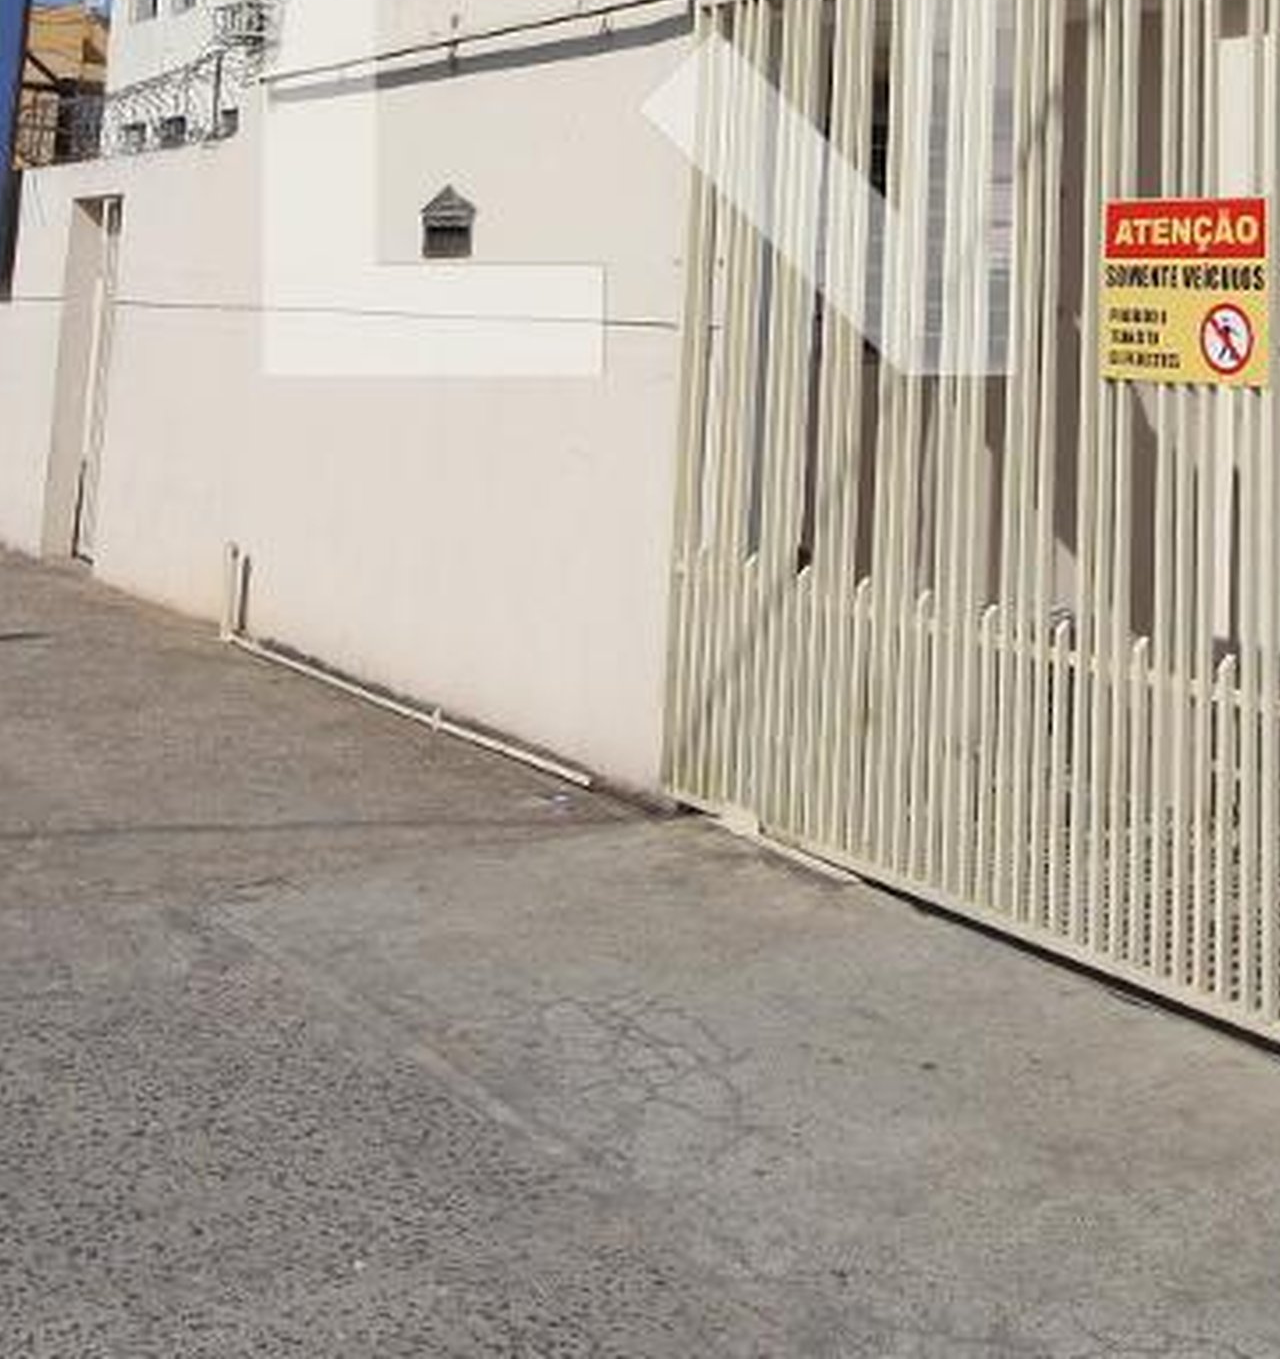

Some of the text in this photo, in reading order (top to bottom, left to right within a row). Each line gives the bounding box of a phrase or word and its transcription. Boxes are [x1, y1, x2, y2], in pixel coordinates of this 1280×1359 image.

[1114, 208, 1260, 254] ATENÇÃO
[1104, 262, 1266, 291] SOMENTE VEÍCULOS
